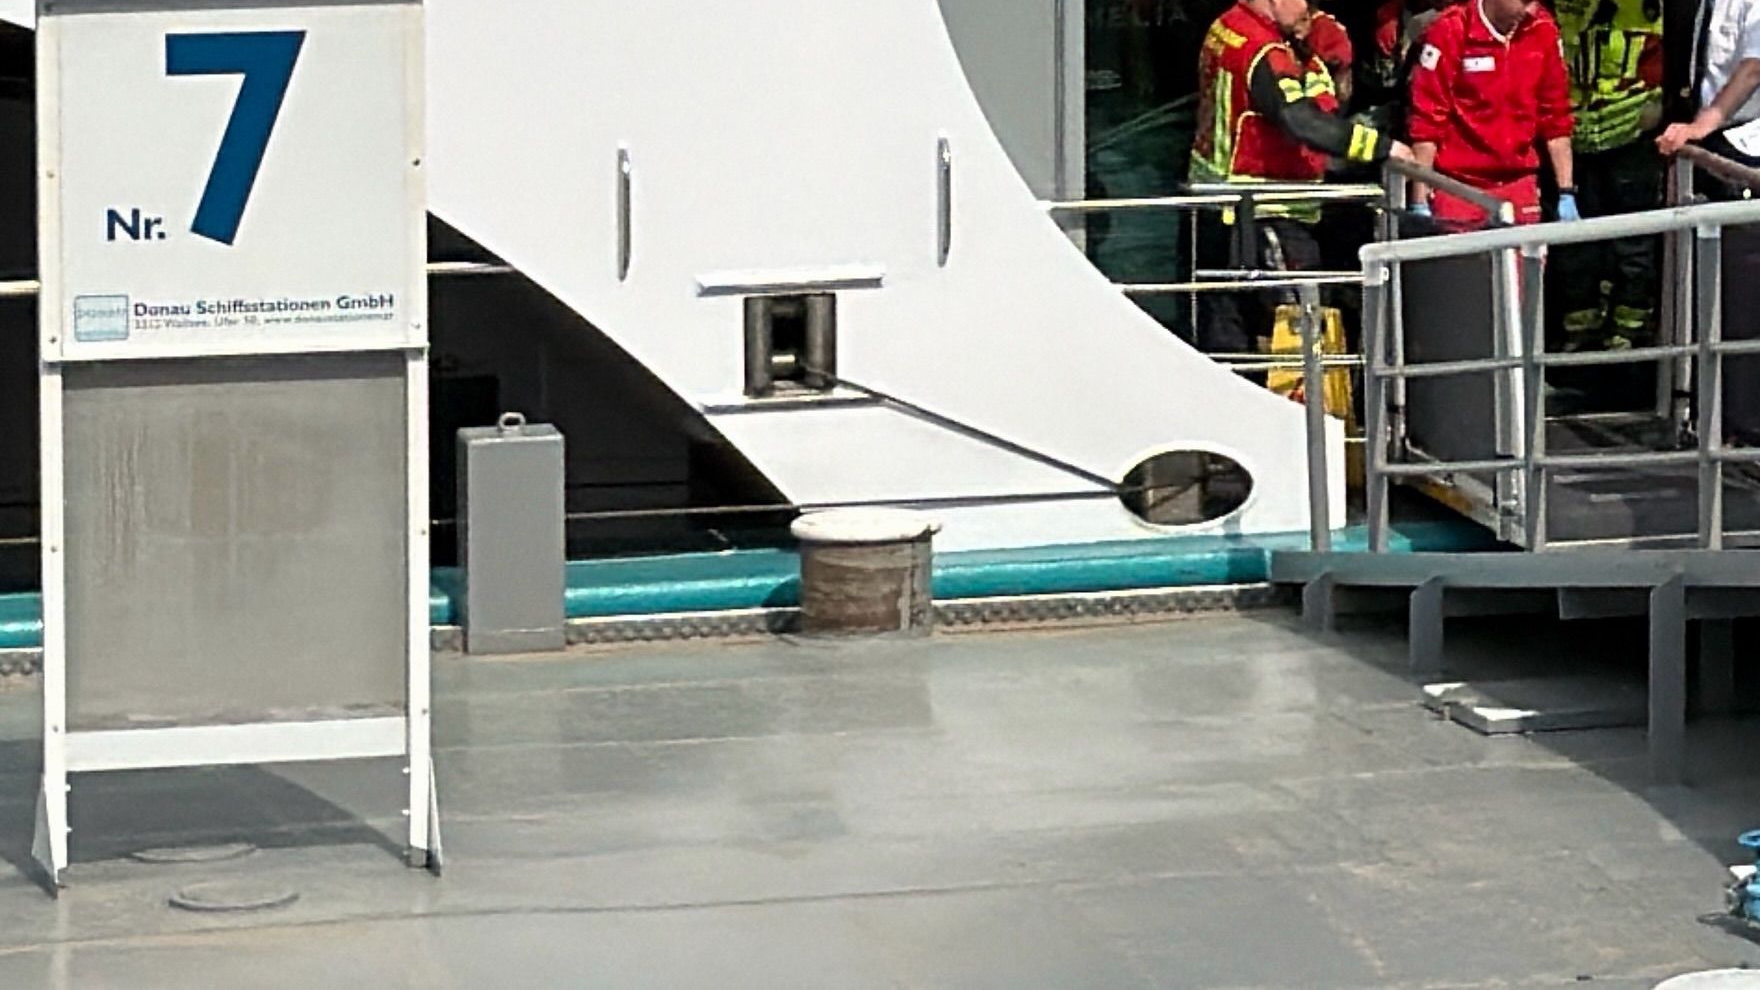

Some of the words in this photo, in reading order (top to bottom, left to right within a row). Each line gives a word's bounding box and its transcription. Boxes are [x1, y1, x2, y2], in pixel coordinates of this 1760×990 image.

[107, 208, 166, 241] Nr.
[165, 30, 307, 246] 7
[134, 302, 191, 317] Donau
[196, 296, 331, 315] Schiffsstationen
[336, 294, 394, 310] GmbH
